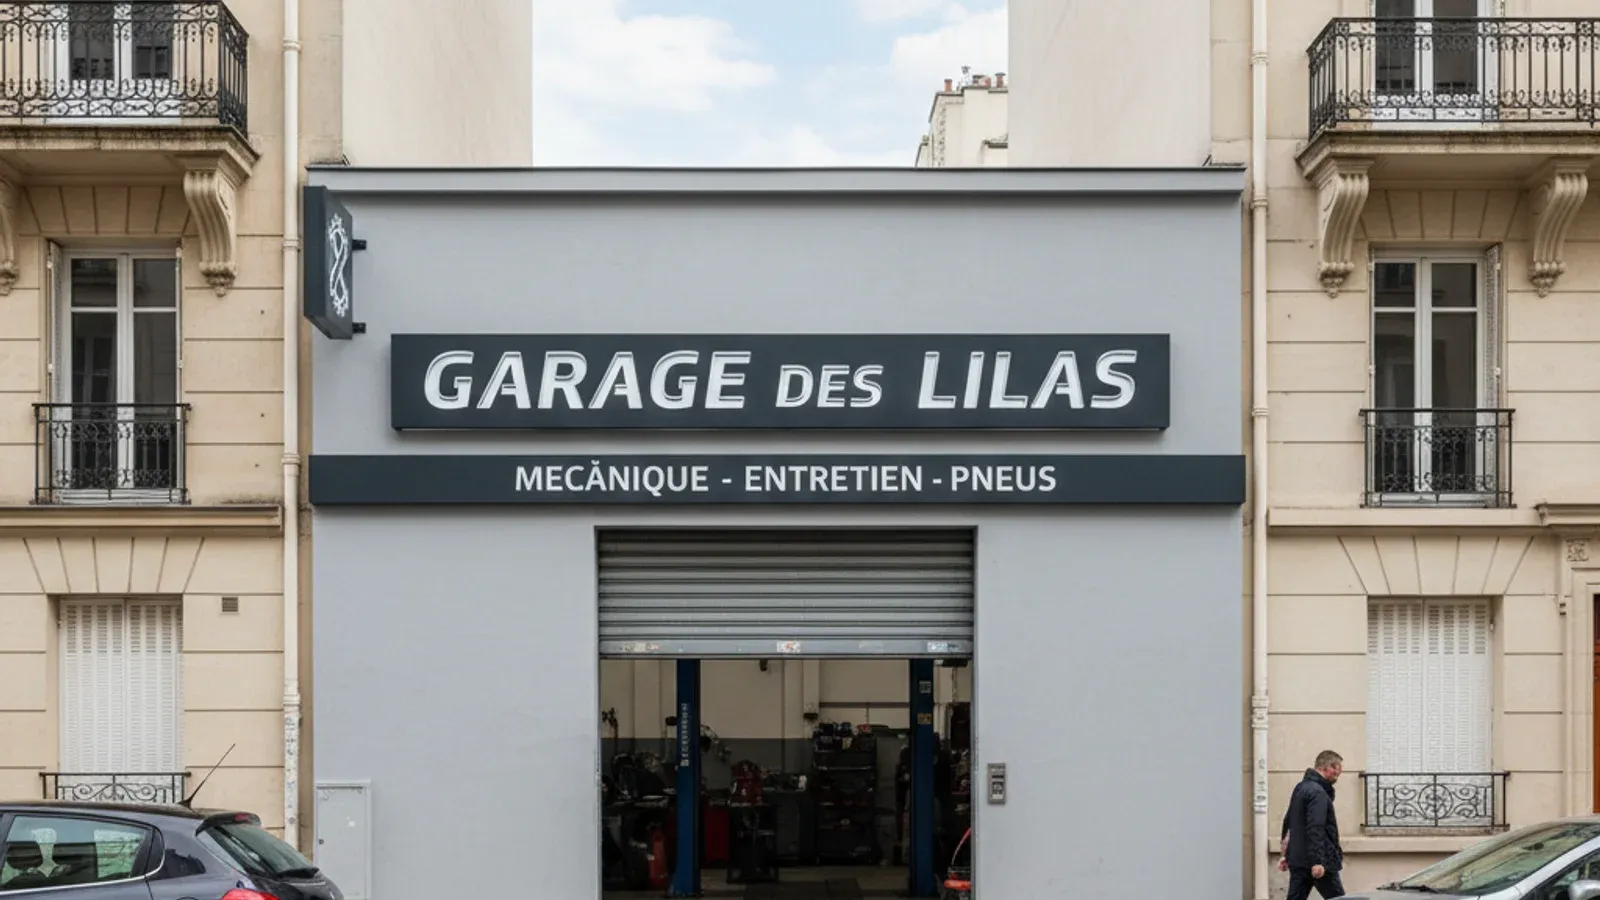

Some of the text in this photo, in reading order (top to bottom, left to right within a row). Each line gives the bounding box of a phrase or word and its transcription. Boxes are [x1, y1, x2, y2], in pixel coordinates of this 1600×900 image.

[424, 349, 1138, 410] GARAGE DES LILAS
[745, 465, 922, 492] ENTRETIEN
[951, 465, 1057, 492] PNEUS
